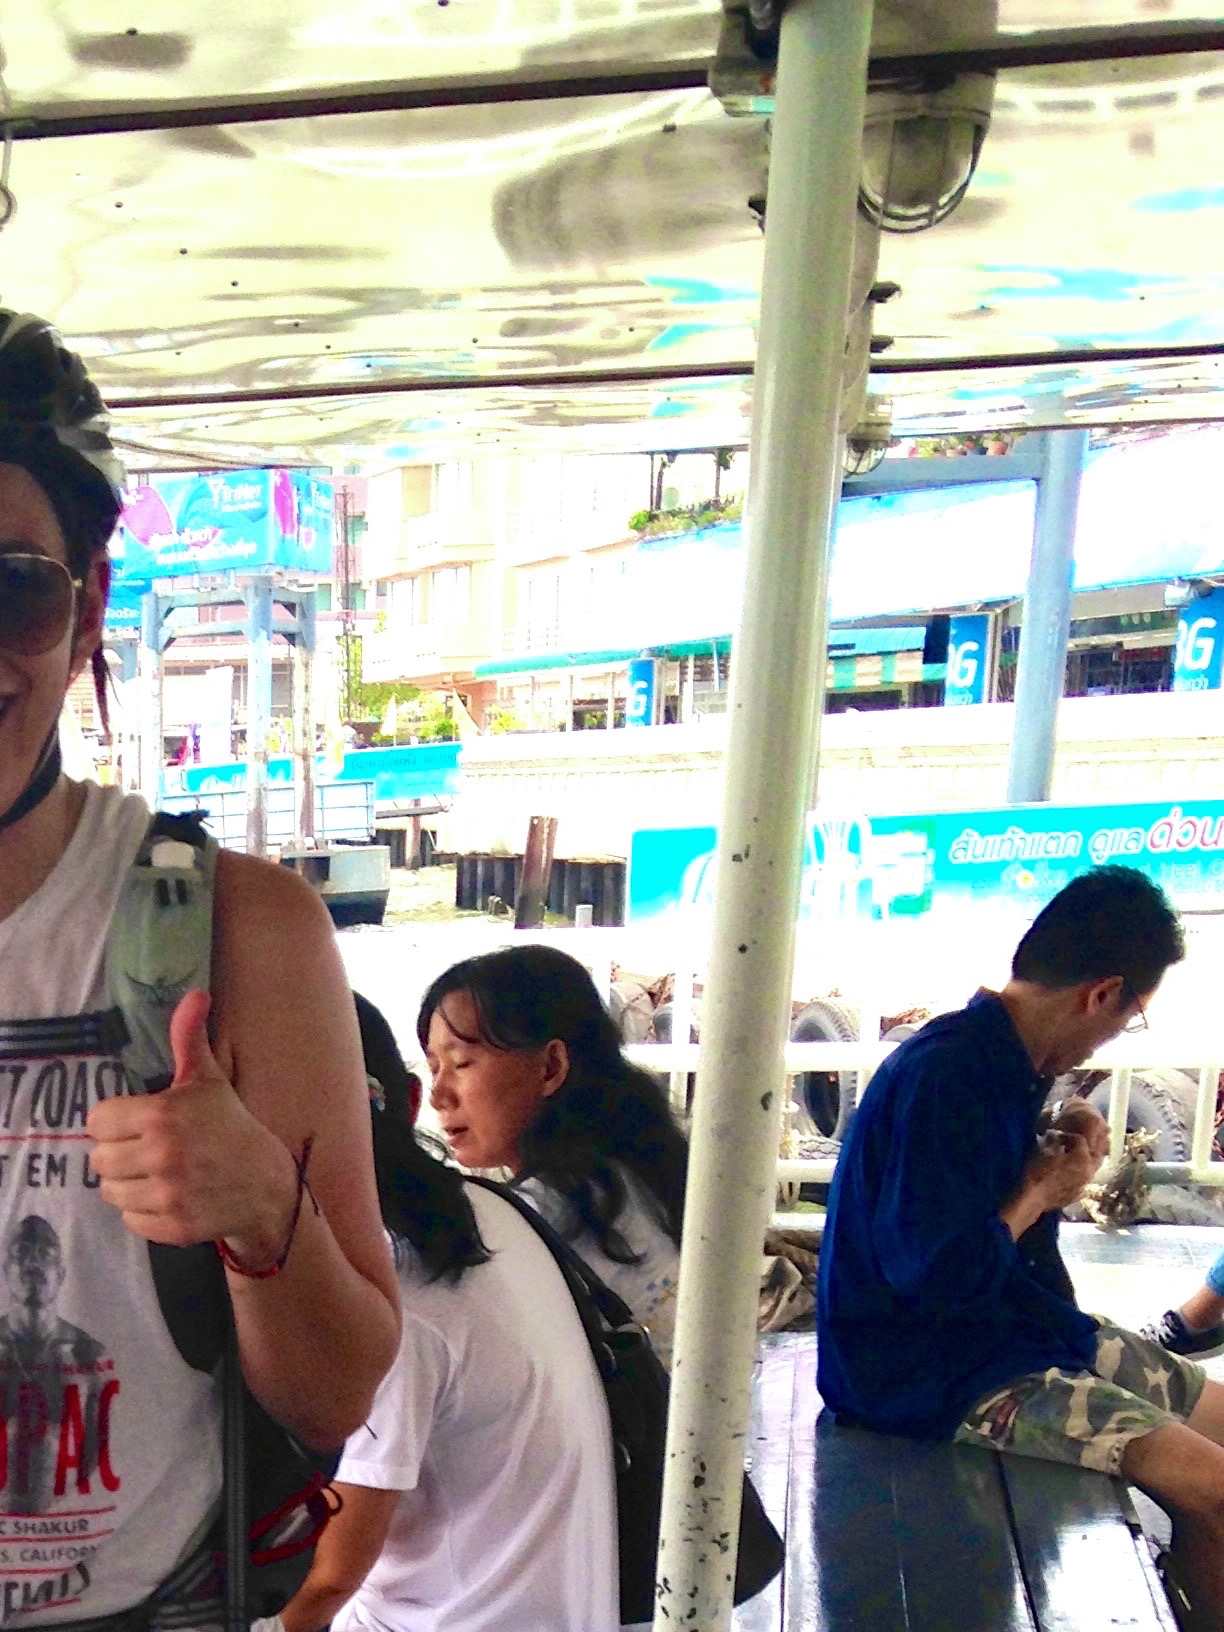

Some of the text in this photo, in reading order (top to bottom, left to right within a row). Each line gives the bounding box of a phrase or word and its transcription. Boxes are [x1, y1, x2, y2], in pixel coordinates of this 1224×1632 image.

[30, 1059, 128, 1128] COAS
[28, 1152, 68, 1189] EM
[13, 1518, 89, 1535] SHAKUR
